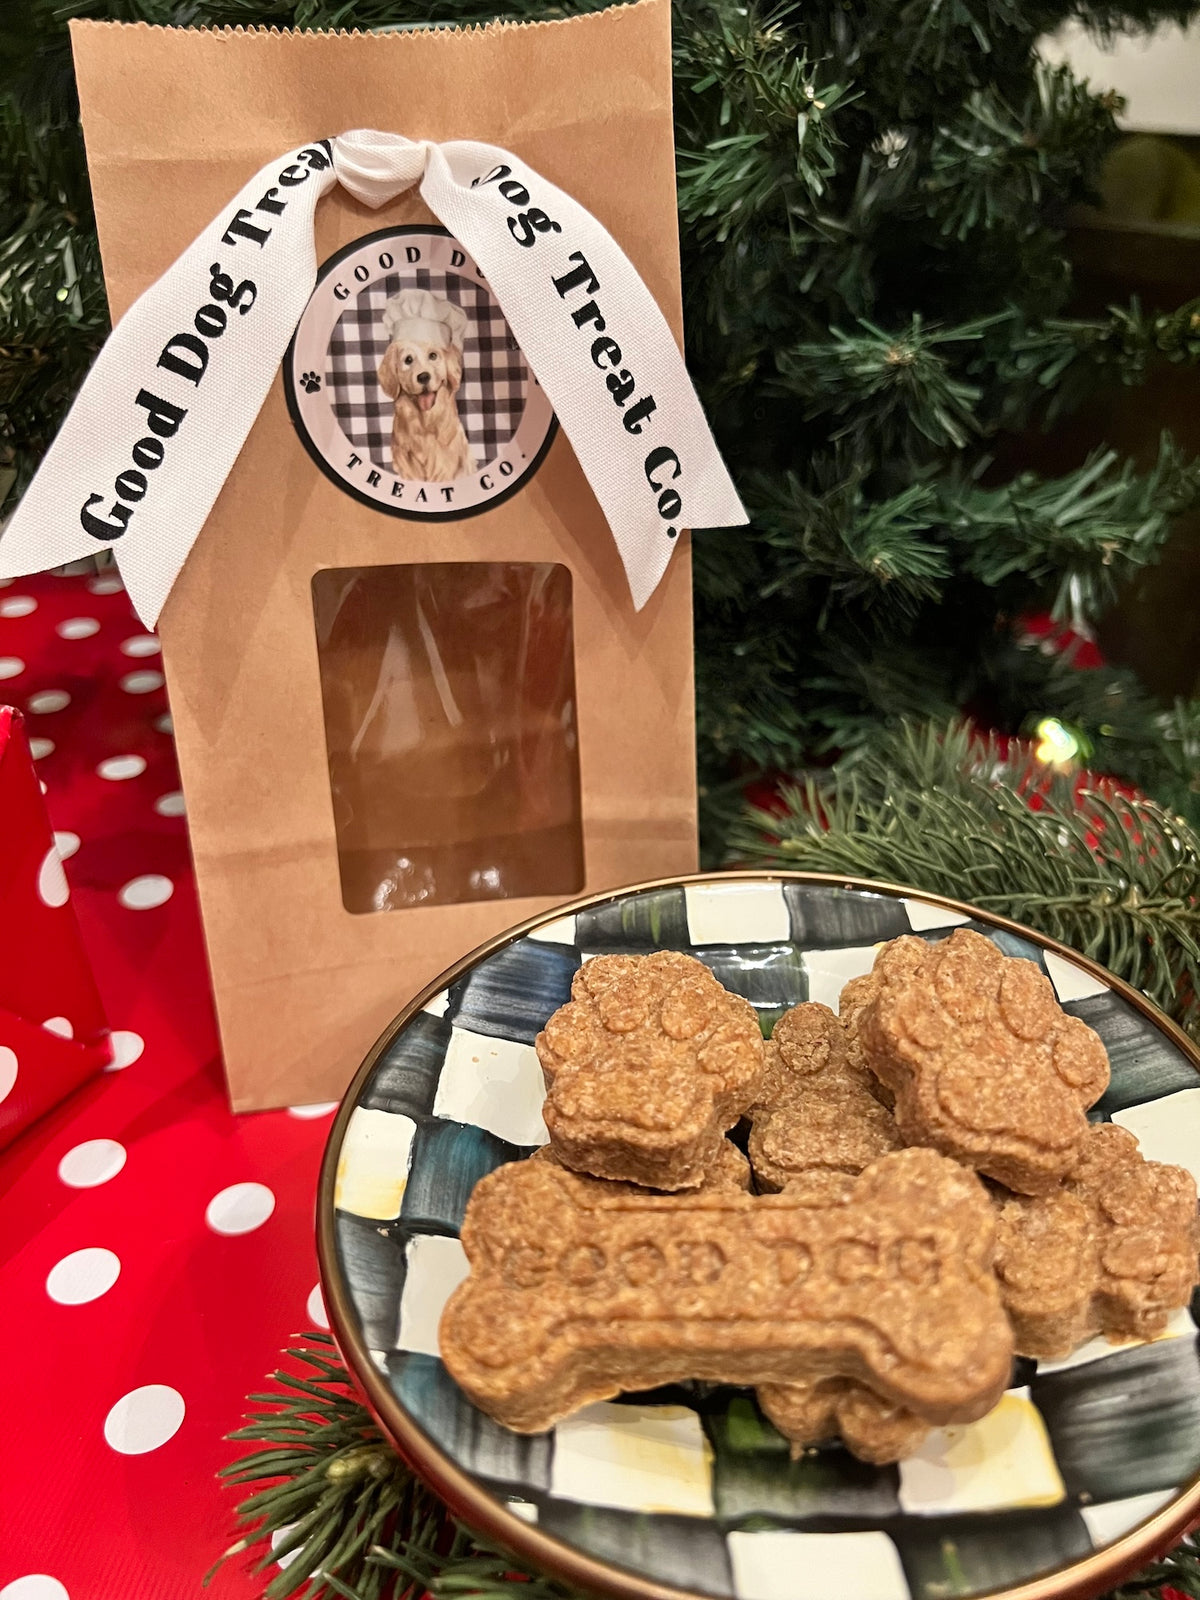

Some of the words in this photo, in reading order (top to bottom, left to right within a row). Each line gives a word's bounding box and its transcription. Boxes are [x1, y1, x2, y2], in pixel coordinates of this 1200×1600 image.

[333, 246, 422, 301] GOOD
[80, 388, 188, 541] Good
[156, 262, 258, 387] Dog
[346, 452, 454, 503] TREAT
[479, 453, 527, 492] CO.
[551, 251, 657, 435] Treat
[643, 446, 683, 538] Co.
